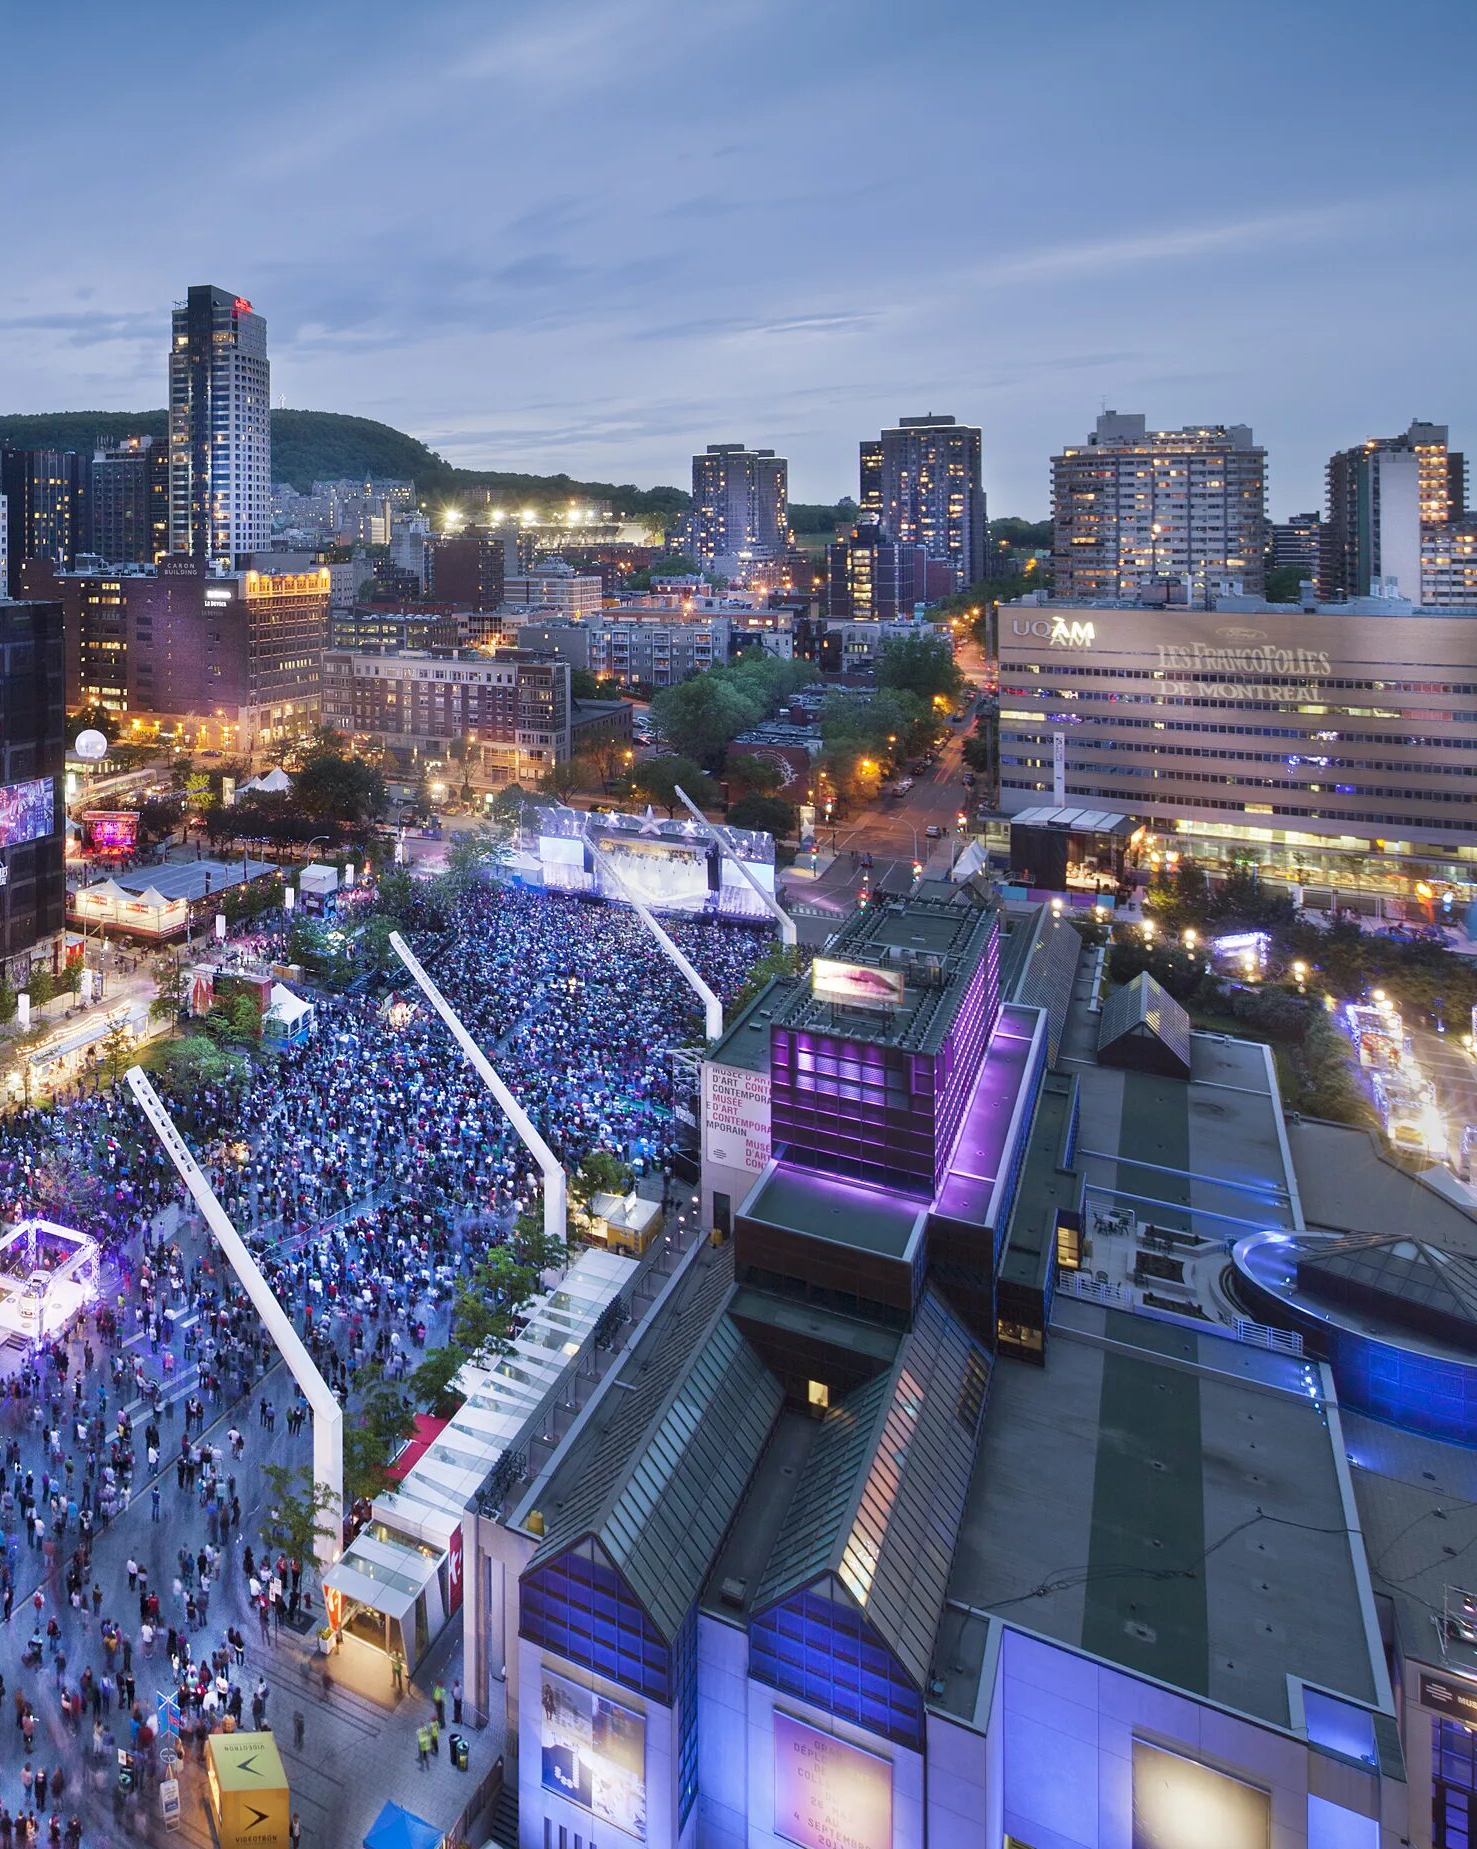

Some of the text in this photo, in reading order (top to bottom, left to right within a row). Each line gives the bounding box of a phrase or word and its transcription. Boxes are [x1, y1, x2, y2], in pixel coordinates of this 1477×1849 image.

[1157, 680, 1195, 697] DE
[713, 1075, 738, 1087] D'ART
[713, 1103, 738, 1115] D'ART
[745, 1148, 771, 1161] D'ART
[793, 1810, 800, 1821] 4
